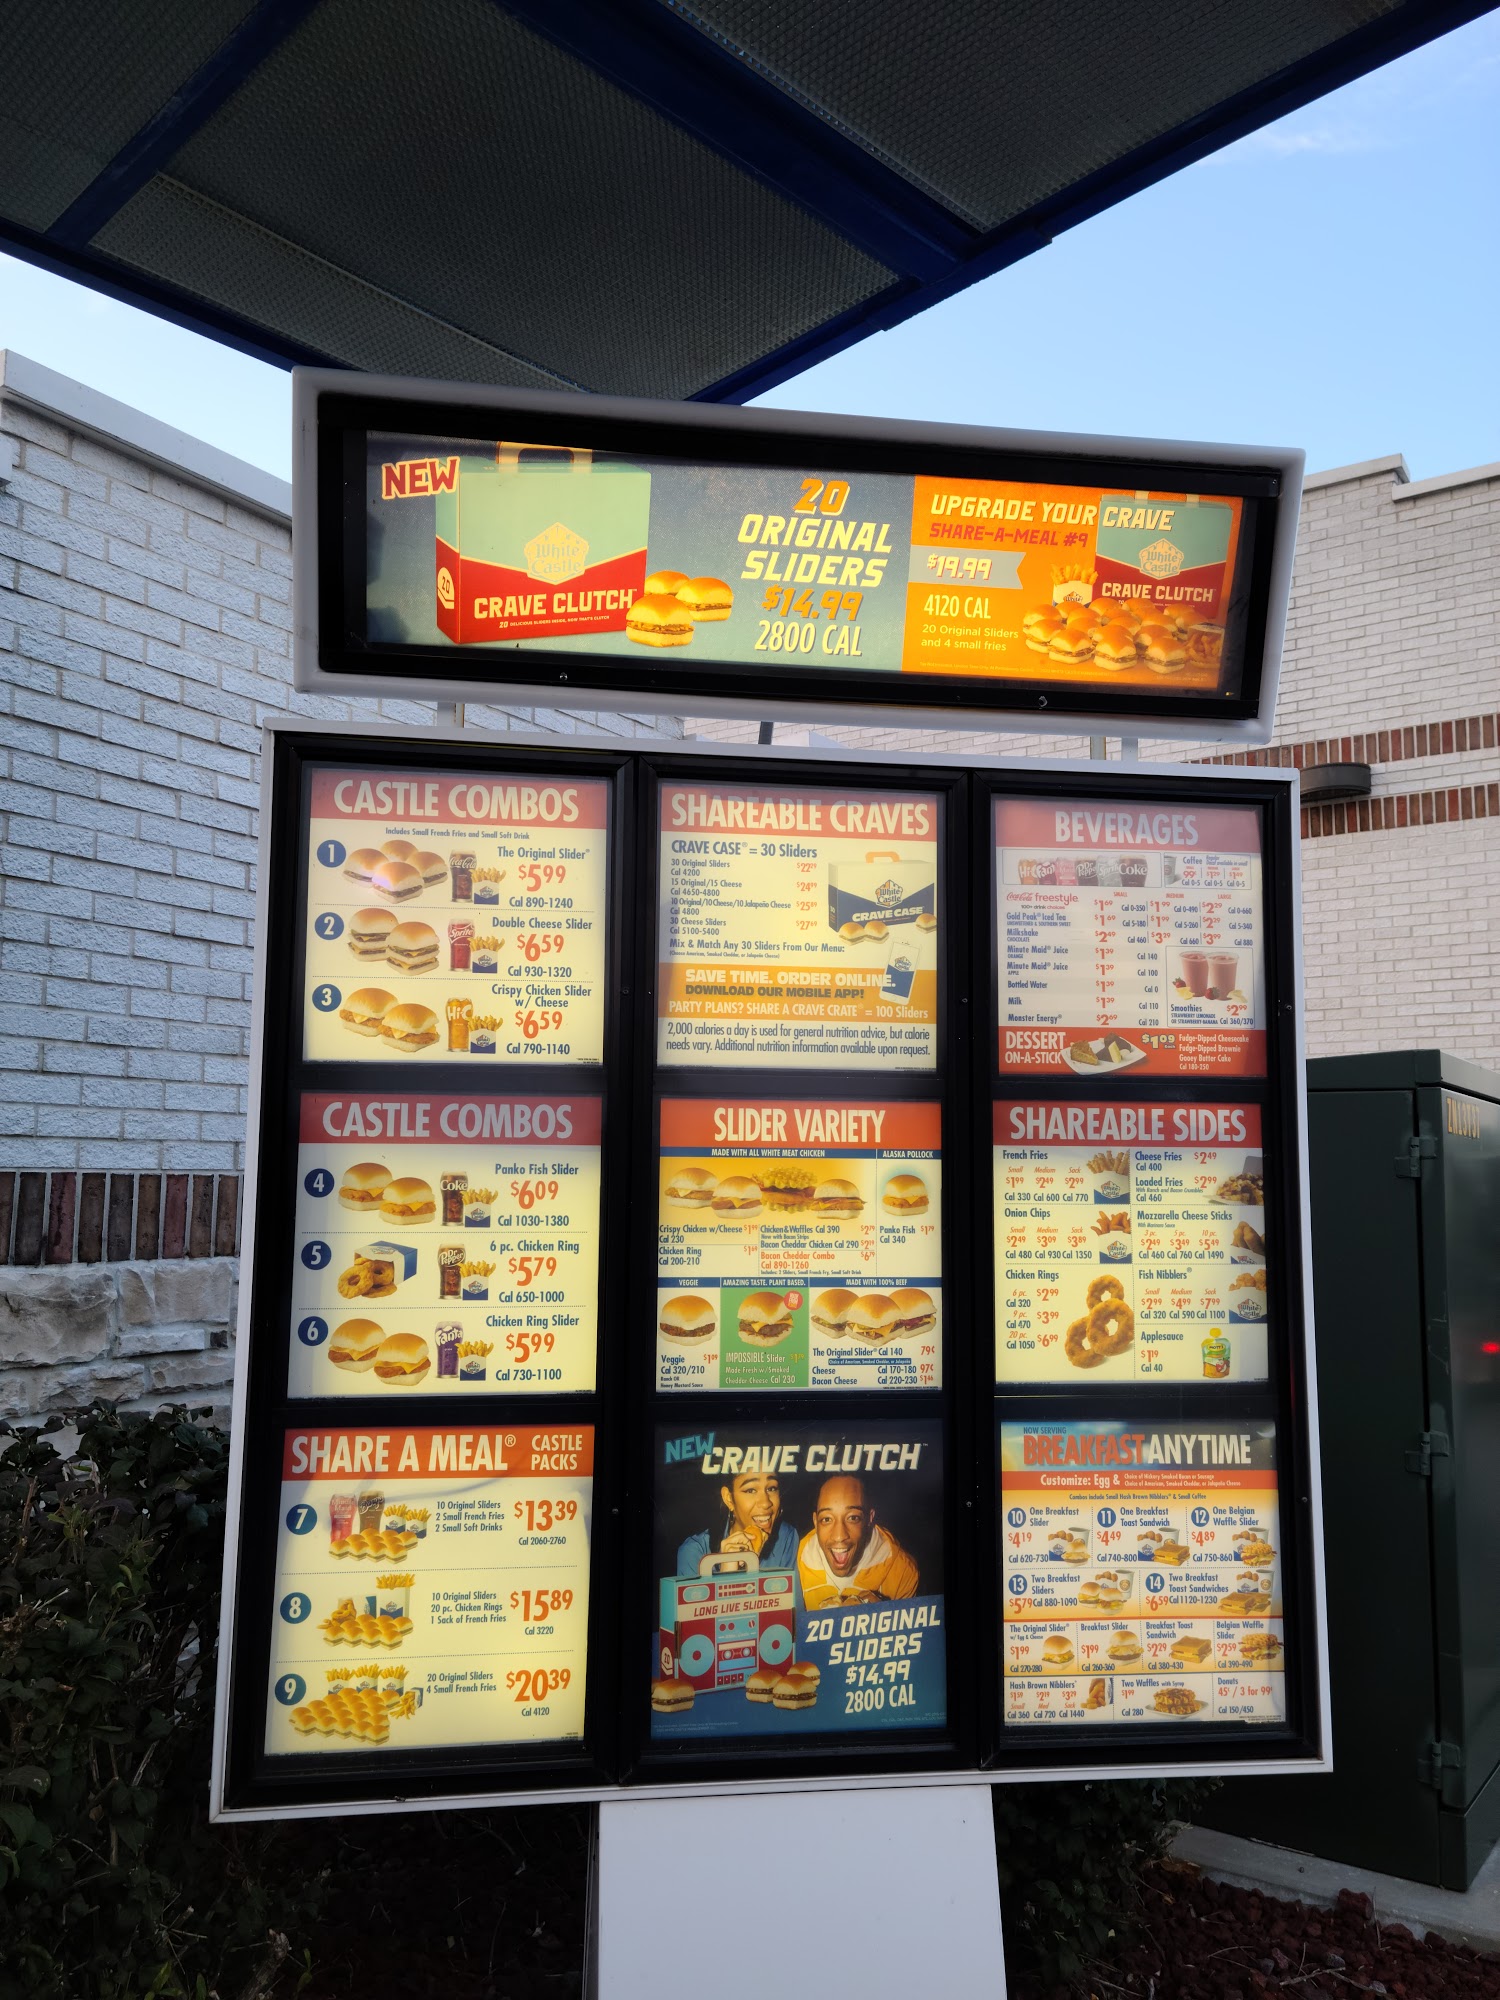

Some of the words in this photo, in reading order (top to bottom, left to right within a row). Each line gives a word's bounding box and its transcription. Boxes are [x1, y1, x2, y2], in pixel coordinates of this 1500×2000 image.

[382, 458, 459, 499] NEW
[793, 478, 850, 516] 20
[931, 494, 1036, 521] UPGRADE
[1041, 502, 1097, 525] YOUR
[1102, 506, 1175, 531] CRAVE
[738, 514, 892, 553] ORIGINAL
[1063, 532, 1088, 547] #9
[536, 544, 579, 558] White
[1147, 551, 1177, 563] White
[531, 559, 582, 574] Castle
[741, 551, 888, 588] SLIDERS
[927, 554, 992, 580] $19.99
[1143, 561, 1179, 574] Castle
[441, 576, 451, 593] 20
[1102, 583, 1152, 598] CRAVE
[1155, 585, 1214, 603] CLUTCH
[474, 594, 546, 619] CRAVE
[553, 589, 633, 613] CLUTCH
[762, 584, 864, 621] $14.99
[924, 595, 959, 617] 4120
[964, 596, 991, 619] CAL
[755, 619, 816, 653] 2800
[822, 624, 862, 656] CAL
[922, 624, 936, 634] 20
[940, 626, 980, 636] Original
[984, 628, 1018, 638] Sliders
[921, 638, 940, 647] and
[944, 639, 950, 647] 4
[954, 640, 981, 649] small
[984, 641, 1006, 651] fries
[334, 780, 439, 816] CASTLE
[449, 785, 578, 822] COMBOS
[672, 793, 821, 831] SHAREABLE
[830, 801, 929, 836] CRAVES
[1055, 811, 1198, 845] BEVERAGES
[328, 844, 334, 862] 1
[498, 846, 514, 858] The
[518, 848, 556, 860] Original
[672, 840, 709, 854] CRAVE
[761, 844, 776, 856] 30
[779, 844, 817, 858] Sliders
[1119, 863, 1147, 875] Coke
[510, 897, 523, 908] Cal
[526, 897, 572, 908] 890-1240
[1035, 893, 1078, 906] freestyle
[324, 916, 334, 935] 2
[492, 917, 525, 928] Double
[528, 918, 562, 929] Cheese
[566, 919, 592, 930] Slider
[686, 969, 726, 983] SAVE
[730, 971, 772, 984] TIME.
[777, 973, 831, 986] ORDER
[835, 974, 896, 987] ONLINE.
[1008, 980, 1028, 989] Bottled
[1030, 981, 1048, 989] Water
[322, 988, 332, 1006] 3
[492, 984, 522, 998] Crispy
[526, 985, 561, 996] Chicken
[564, 986, 592, 996] Slider
[686, 985, 754, 997] DOWNLOAD
[758, 987, 783, 997] OUR
[786, 988, 831, 998] MOBILE
[835, 989, 864, 998] APP!
[1171, 1004, 1202, 1013] Smoothies
[1008, 1014, 1034, 1022] Monster
[1005, 1031, 1066, 1049] DESSERT
[1005, 1051, 1061, 1064] ON-A-STICK
[322, 1102, 430, 1138] CASTLE
[440, 1104, 572, 1138] COMBOS
[714, 1108, 787, 1142] SLIDER
[794, 1109, 885, 1142] VARIETY
[1009, 1107, 1164, 1141] SHAREABLE
[1173, 1109, 1246, 1142] SIDES
[749, 1149, 759, 1157] ALL
[761, 1149, 780, 1157] WHITE
[782, 1149, 798, 1157] MEAT
[1003, 1151, 1028, 1160] French
[1030, 1151, 1048, 1160] Fries
[1135, 1152, 1161, 1161] Cheese
[1163, 1152, 1182, 1162] Fries
[495, 1164, 526, 1175] Panko
[529, 1164, 548, 1174] Fish
[551, 1164, 578, 1175] Slider
[313, 1173, 324, 1192] 4
[440, 1180, 468, 1191] Coke
[1005, 1208, 1029, 1218] Onion
[1031, 1209, 1050, 1219] Chips
[1137, 1210, 1180, 1220] Mozzarella
[1181, 1210, 1208, 1221] Cheese
[1210, 1211, 1233, 1221] Sticks
[311, 1246, 322, 1264] 5
[1006, 1270, 1035, 1280] Chicken
[1038, 1270, 1059, 1281] Rings
[1139, 1270, 1154, 1279] Fish
[307, 1321, 318, 1340] 6
[486, 1316, 522, 1327] Chicken
[526, 1316, 549, 1328] Ring
[552, 1316, 580, 1326] Slider
[1141, 1332, 1183, 1342] Applesauce
[532, 1434, 582, 1451] CASTLE
[664, 1432, 714, 1465] NEW
[1023, 1435, 1146, 1465] BREAKFAST
[1149, 1434, 1251, 1464] ANYTIME
[291, 1435, 390, 1473] SHARE
[398, 1435, 420, 1472] A
[531, 1453, 578, 1470] PACKS
[702, 1444, 800, 1475] CRAVE
[805, 1444, 922, 1472] CLUTCH
[1041, 1474, 1091, 1486] Customize:
[1094, 1475, 1110, 1488] Egg
[1113, 1475, 1120, 1485] &
[295, 1509, 308, 1529] 7
[1011, 1511, 1023, 1524] 10
[1101, 1511, 1112, 1524] 11
[1194, 1510, 1207, 1523] 12
[519, 1537, 529, 1545] Cal
[530, 1536, 566, 1546] 2060-2760
[1012, 1578, 1024, 1591] 13
[1149, 1576, 1162, 1589] 14
[289, 1597, 301, 1618] 8
[694, 1605, 718, 1617] LONG
[721, 1603, 740, 1613] LIVE
[743, 1598, 780, 1610] SLIDERS
[805, 1618, 834, 1642] 20
[840, 1605, 940, 1638] ORIGINAL
[828, 1632, 922, 1665] SLIDERS
[846, 1660, 910, 1686] $14.99
[283, 1678, 297, 1700] 9
[845, 1688, 884, 1714] 2800
[889, 1684, 916, 1707] CAL
